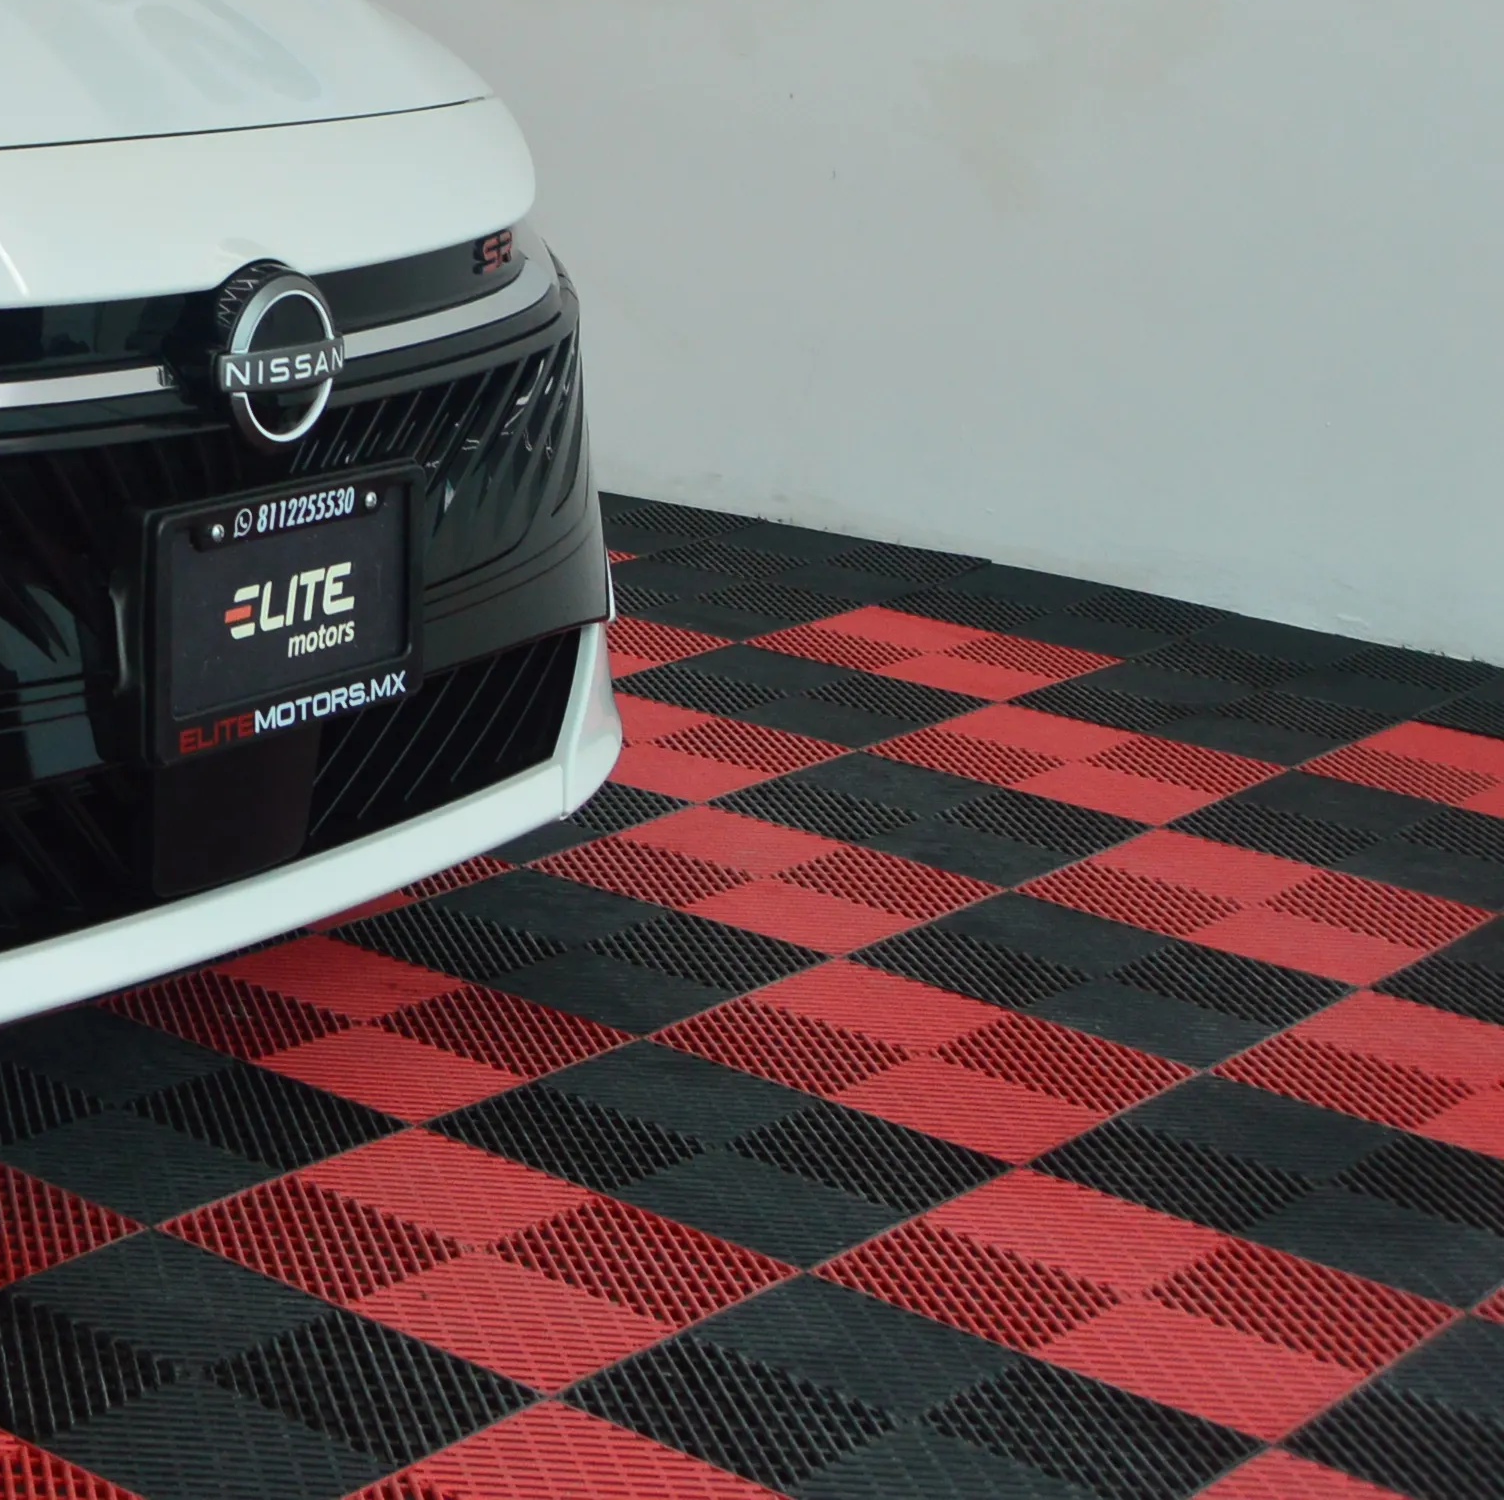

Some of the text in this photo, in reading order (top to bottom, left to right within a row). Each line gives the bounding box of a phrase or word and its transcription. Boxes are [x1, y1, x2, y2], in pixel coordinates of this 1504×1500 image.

[479, 229, 513, 273] SR
[225, 345, 344, 387] NISSAN
[256, 486, 355, 534] 8112255530
[224, 561, 355, 640] ELITE
[287, 620, 355, 658] motors
[179, 670, 406, 754] ELITEMOTORS.MX
